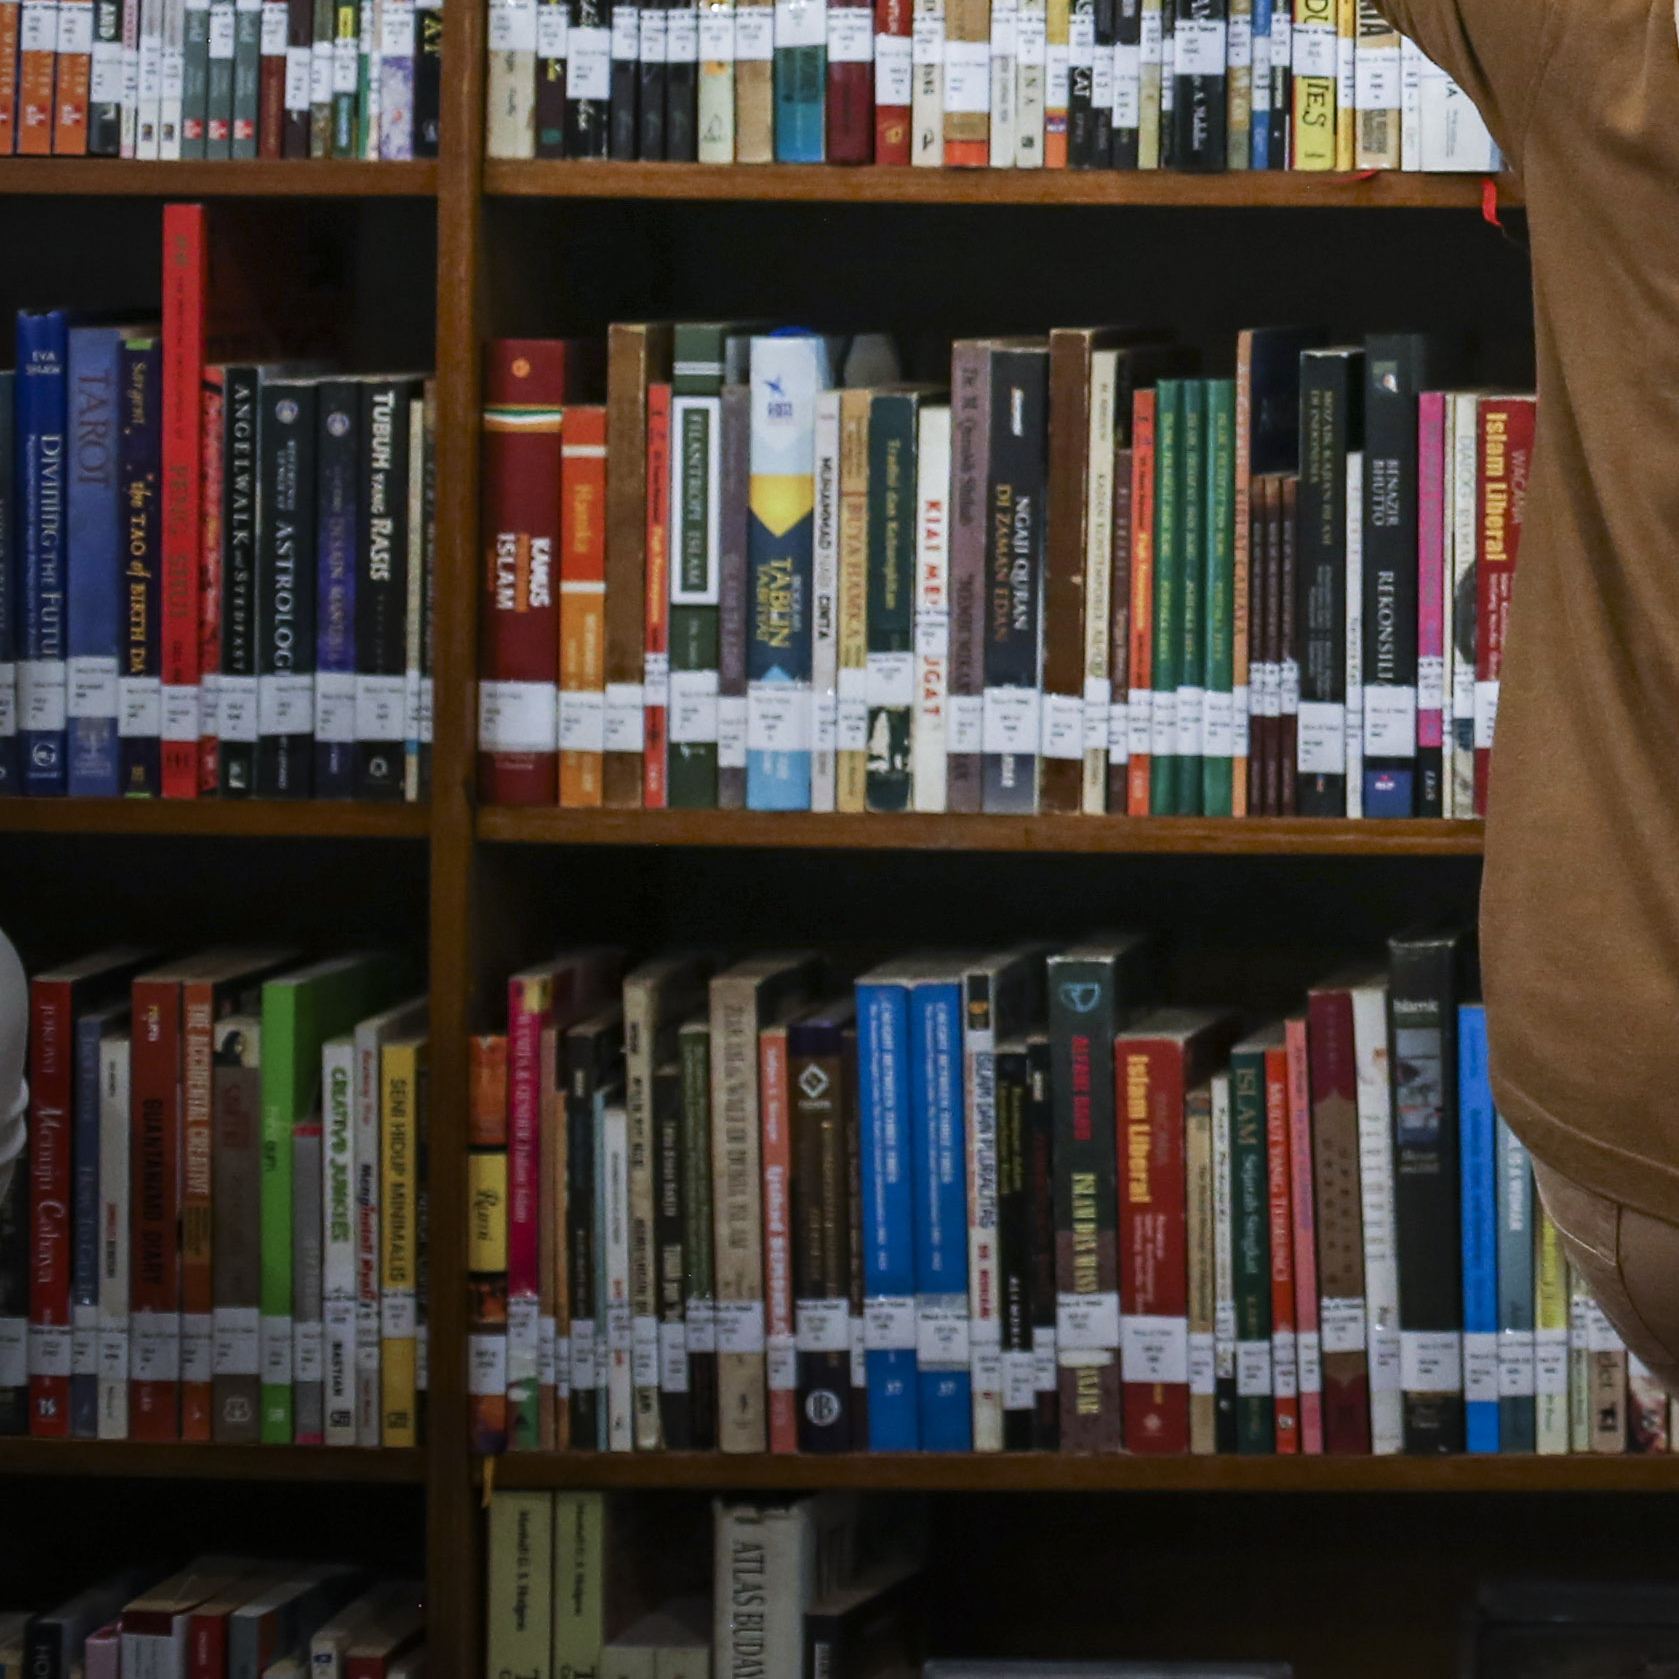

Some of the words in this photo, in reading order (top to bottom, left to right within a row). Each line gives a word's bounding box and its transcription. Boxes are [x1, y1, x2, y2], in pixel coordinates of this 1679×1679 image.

[77, 371, 111, 489] TAROT
[1013, 496, 1031, 553] NGAJI
[1012, 558, 1029, 630] QURAN
[390, 1078, 408, 1118] SENI
[1127, 1055, 1147, 1119] Islam
[391, 1123, 408, 1176] HIDUP
[1128, 1125, 1150, 1203] Liberal
[390, 1182, 407, 1281] MINIMALIS
